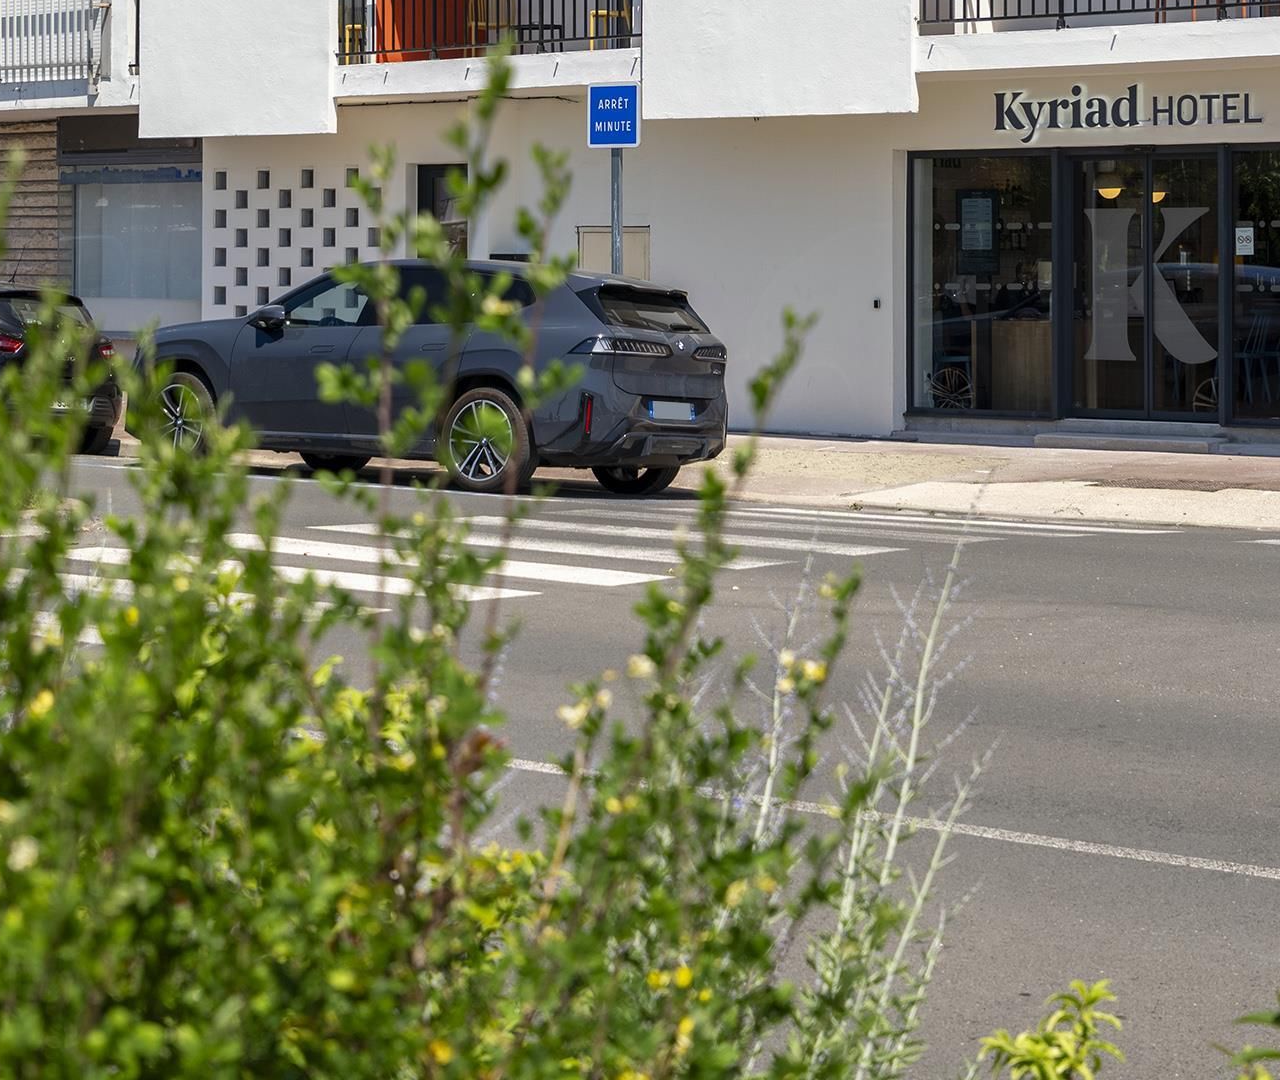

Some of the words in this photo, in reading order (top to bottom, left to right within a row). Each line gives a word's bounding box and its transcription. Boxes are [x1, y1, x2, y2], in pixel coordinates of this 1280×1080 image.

[598, 96, 629, 110] ARRÊT
[994, 84, 1139, 144] Kyriad
[1153, 93, 1263, 126] HOTEL
[595, 120, 632, 133] MINUTE
[1084, 207, 1218, 364] K
